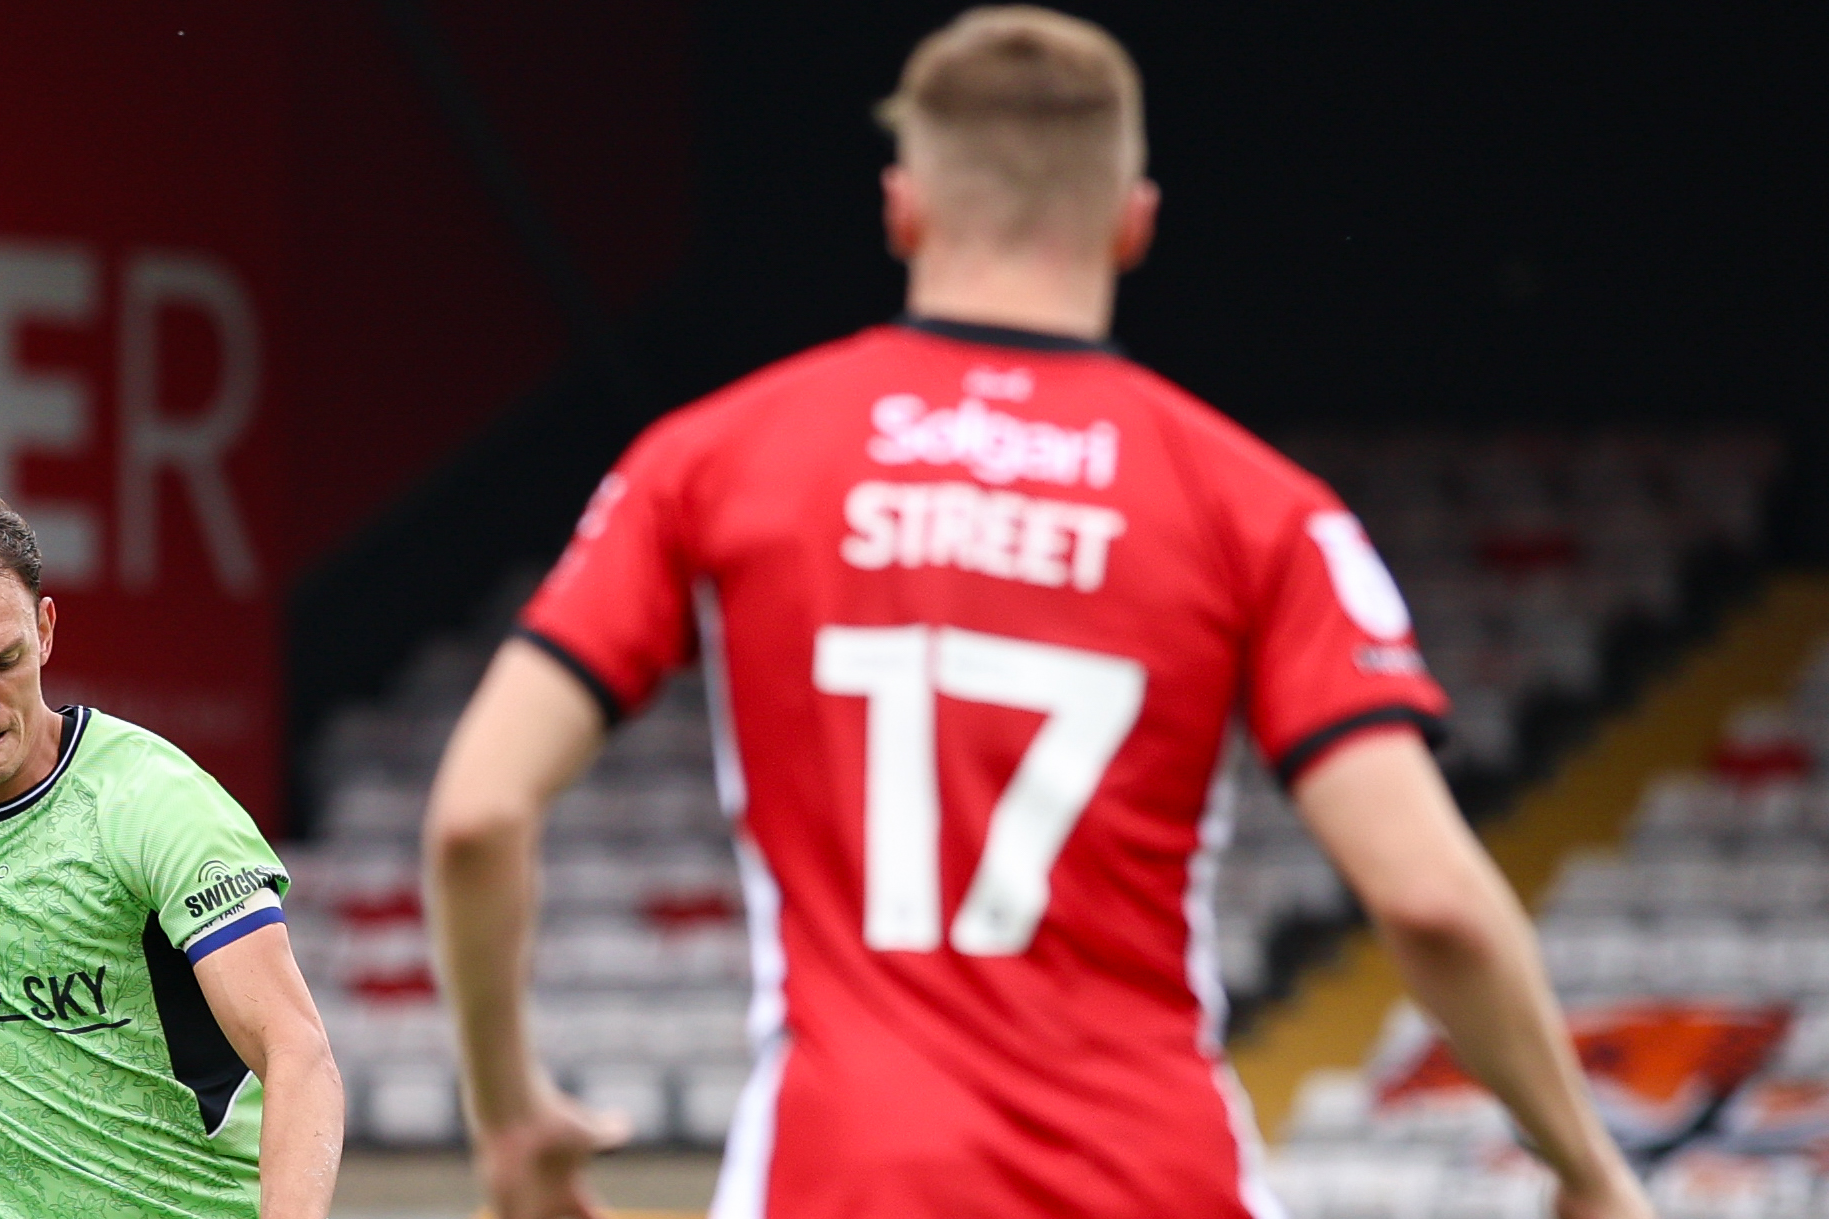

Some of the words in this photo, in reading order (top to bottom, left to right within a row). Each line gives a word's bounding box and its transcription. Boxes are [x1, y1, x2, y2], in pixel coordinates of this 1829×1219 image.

[841, 480, 1127, 593] STREET
[812, 623, 1147, 955] 17
[23, 964, 107, 1021] SKY
